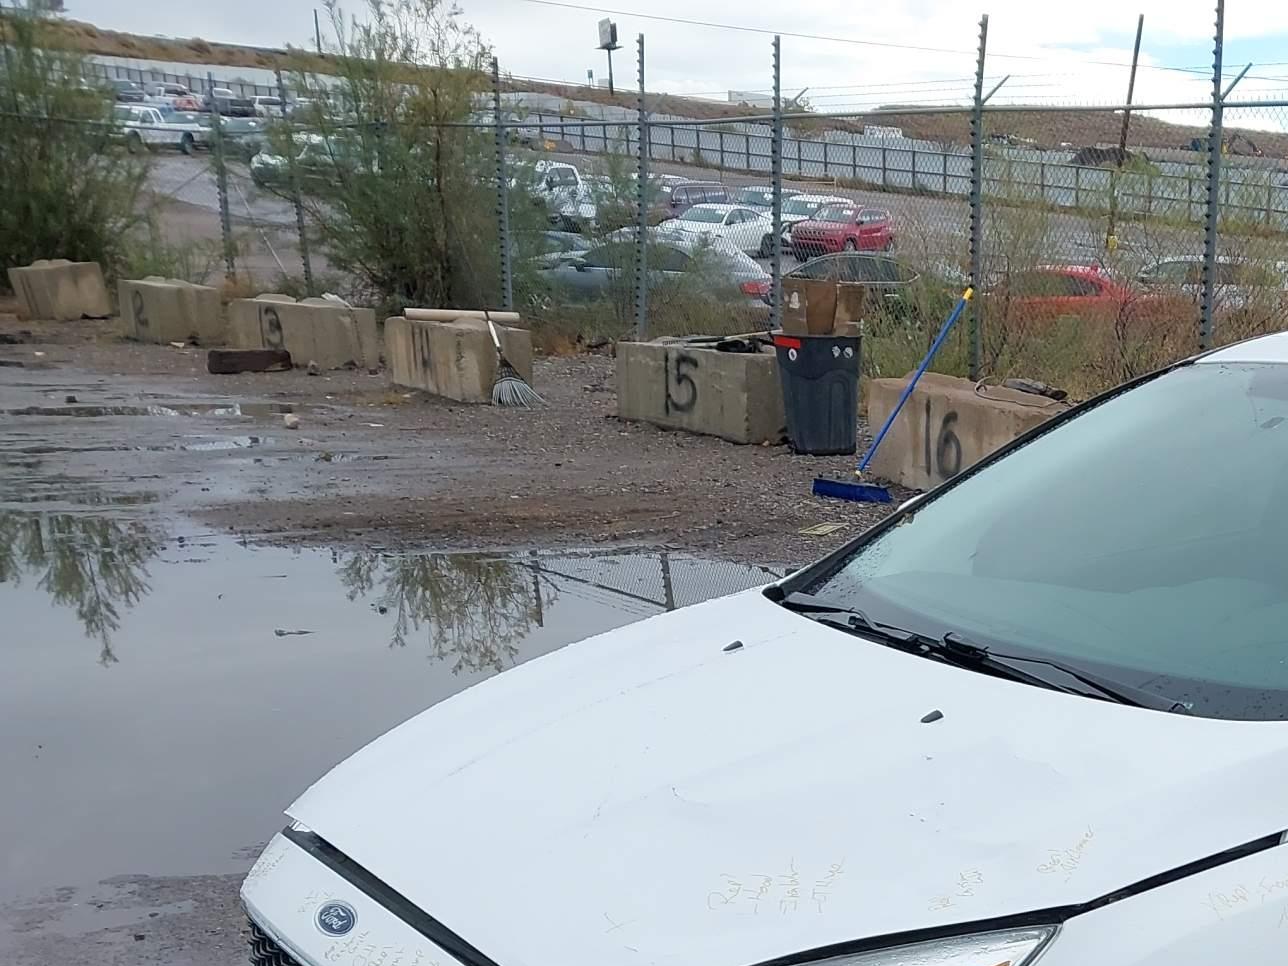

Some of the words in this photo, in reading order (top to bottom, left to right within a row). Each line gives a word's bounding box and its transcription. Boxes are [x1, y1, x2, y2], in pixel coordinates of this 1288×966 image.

[664, 351, 699, 416] 15
[922, 397, 962, 478] 16
[321, 906, 348, 930] Ford
